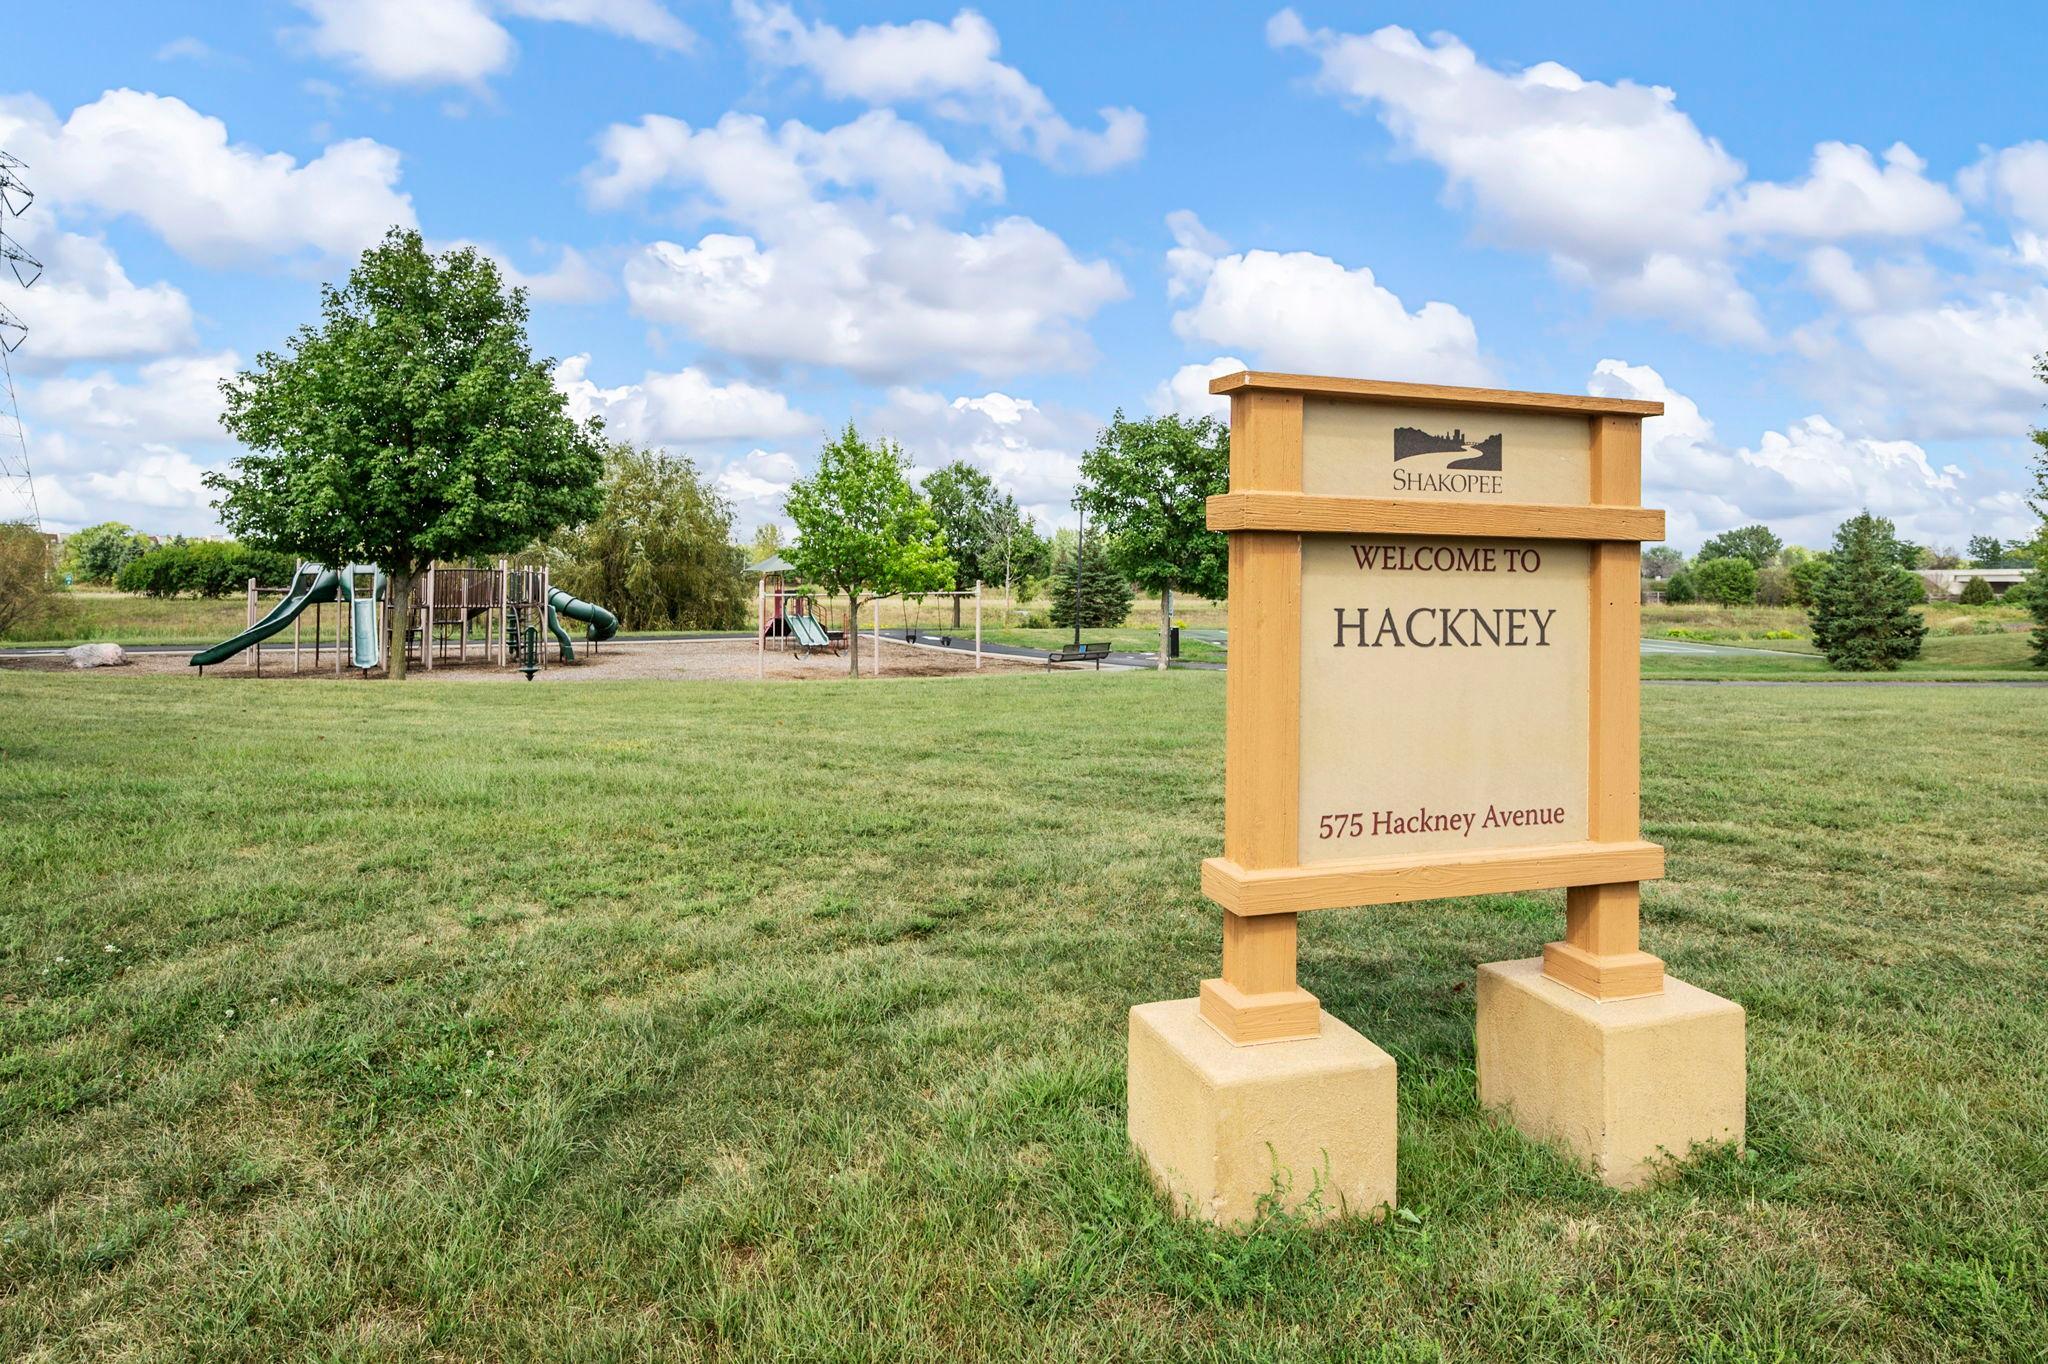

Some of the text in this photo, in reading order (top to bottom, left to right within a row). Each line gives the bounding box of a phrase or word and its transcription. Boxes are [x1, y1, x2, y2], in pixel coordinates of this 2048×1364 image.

[1393, 468, 1502, 494] SHAKOPEE
[1351, 545, 1541, 573] WELCOME TO
[1333, 607, 1556, 648] HACKNEY
[1319, 805, 1565, 839] 575 Hackney Avenue
